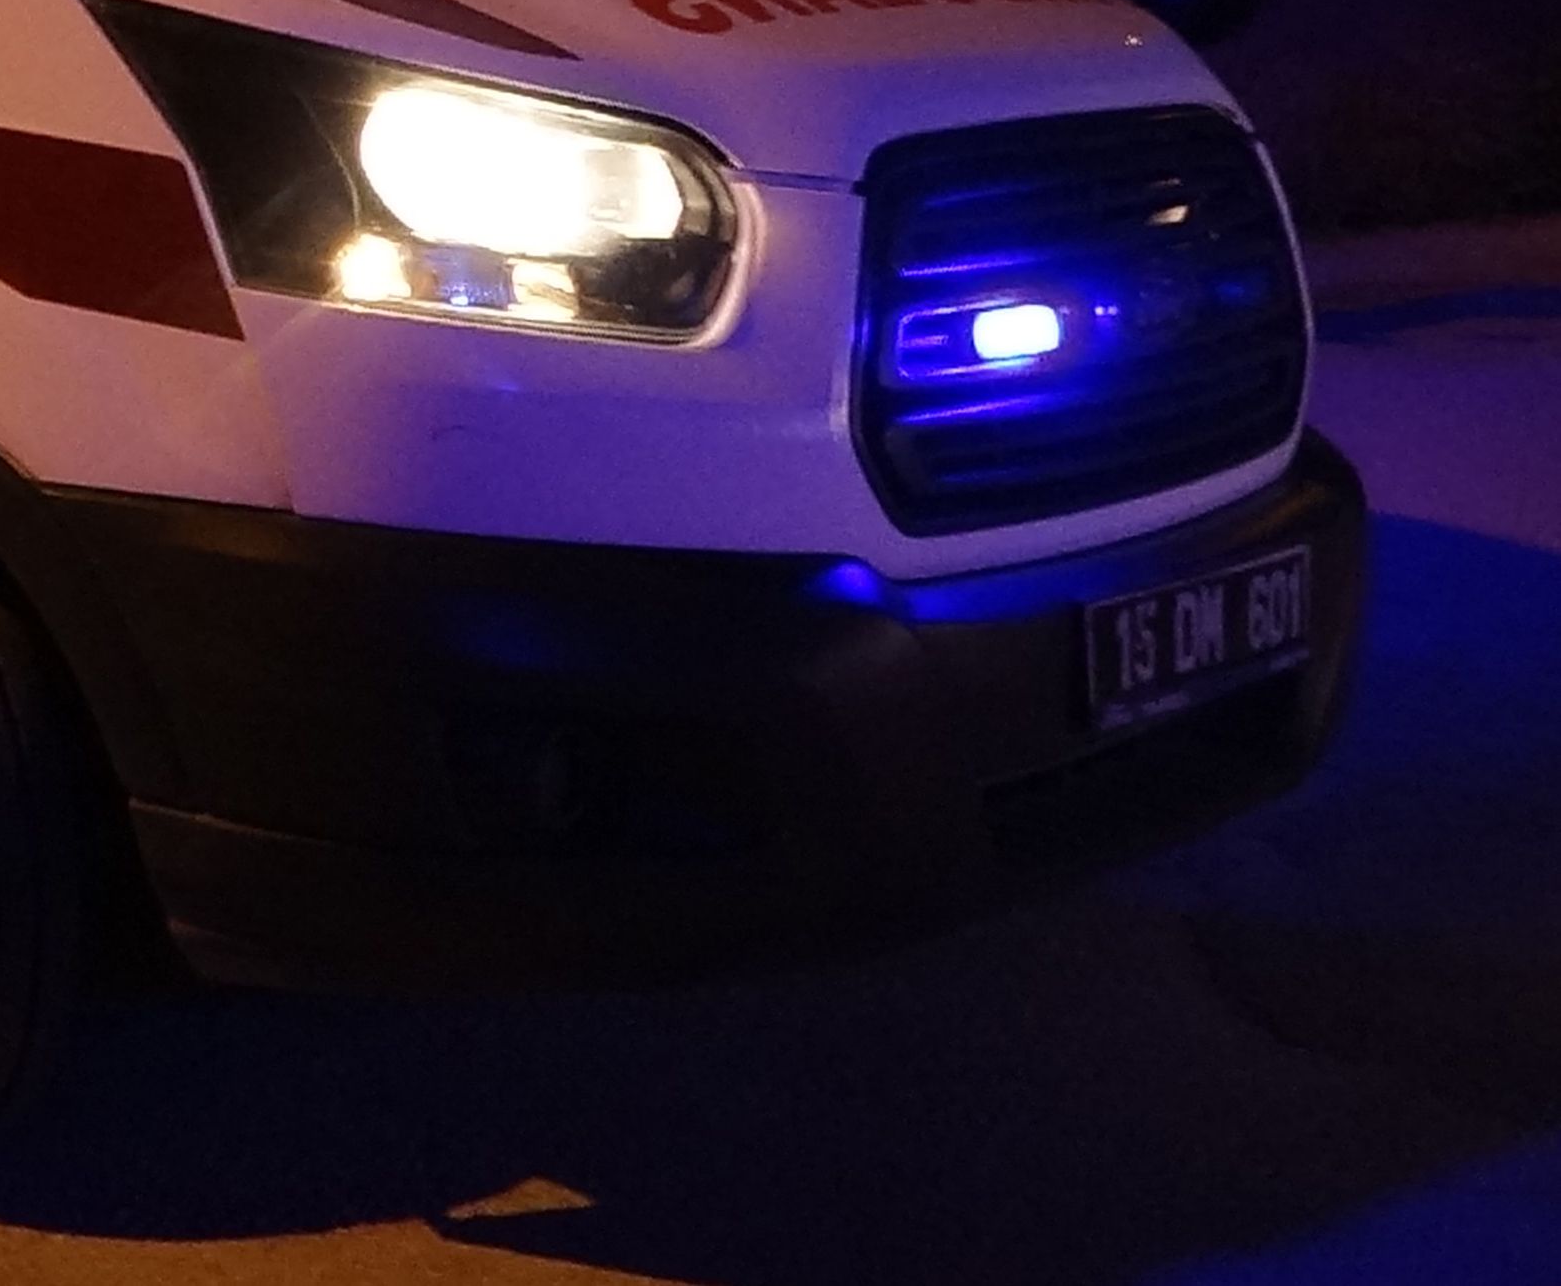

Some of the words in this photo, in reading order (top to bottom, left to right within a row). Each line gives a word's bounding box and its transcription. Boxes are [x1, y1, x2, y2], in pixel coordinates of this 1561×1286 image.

[1115, 599, 1158, 691] 15
[1173, 583, 1225, 674] DM
[1247, 563, 1301, 652] 601
